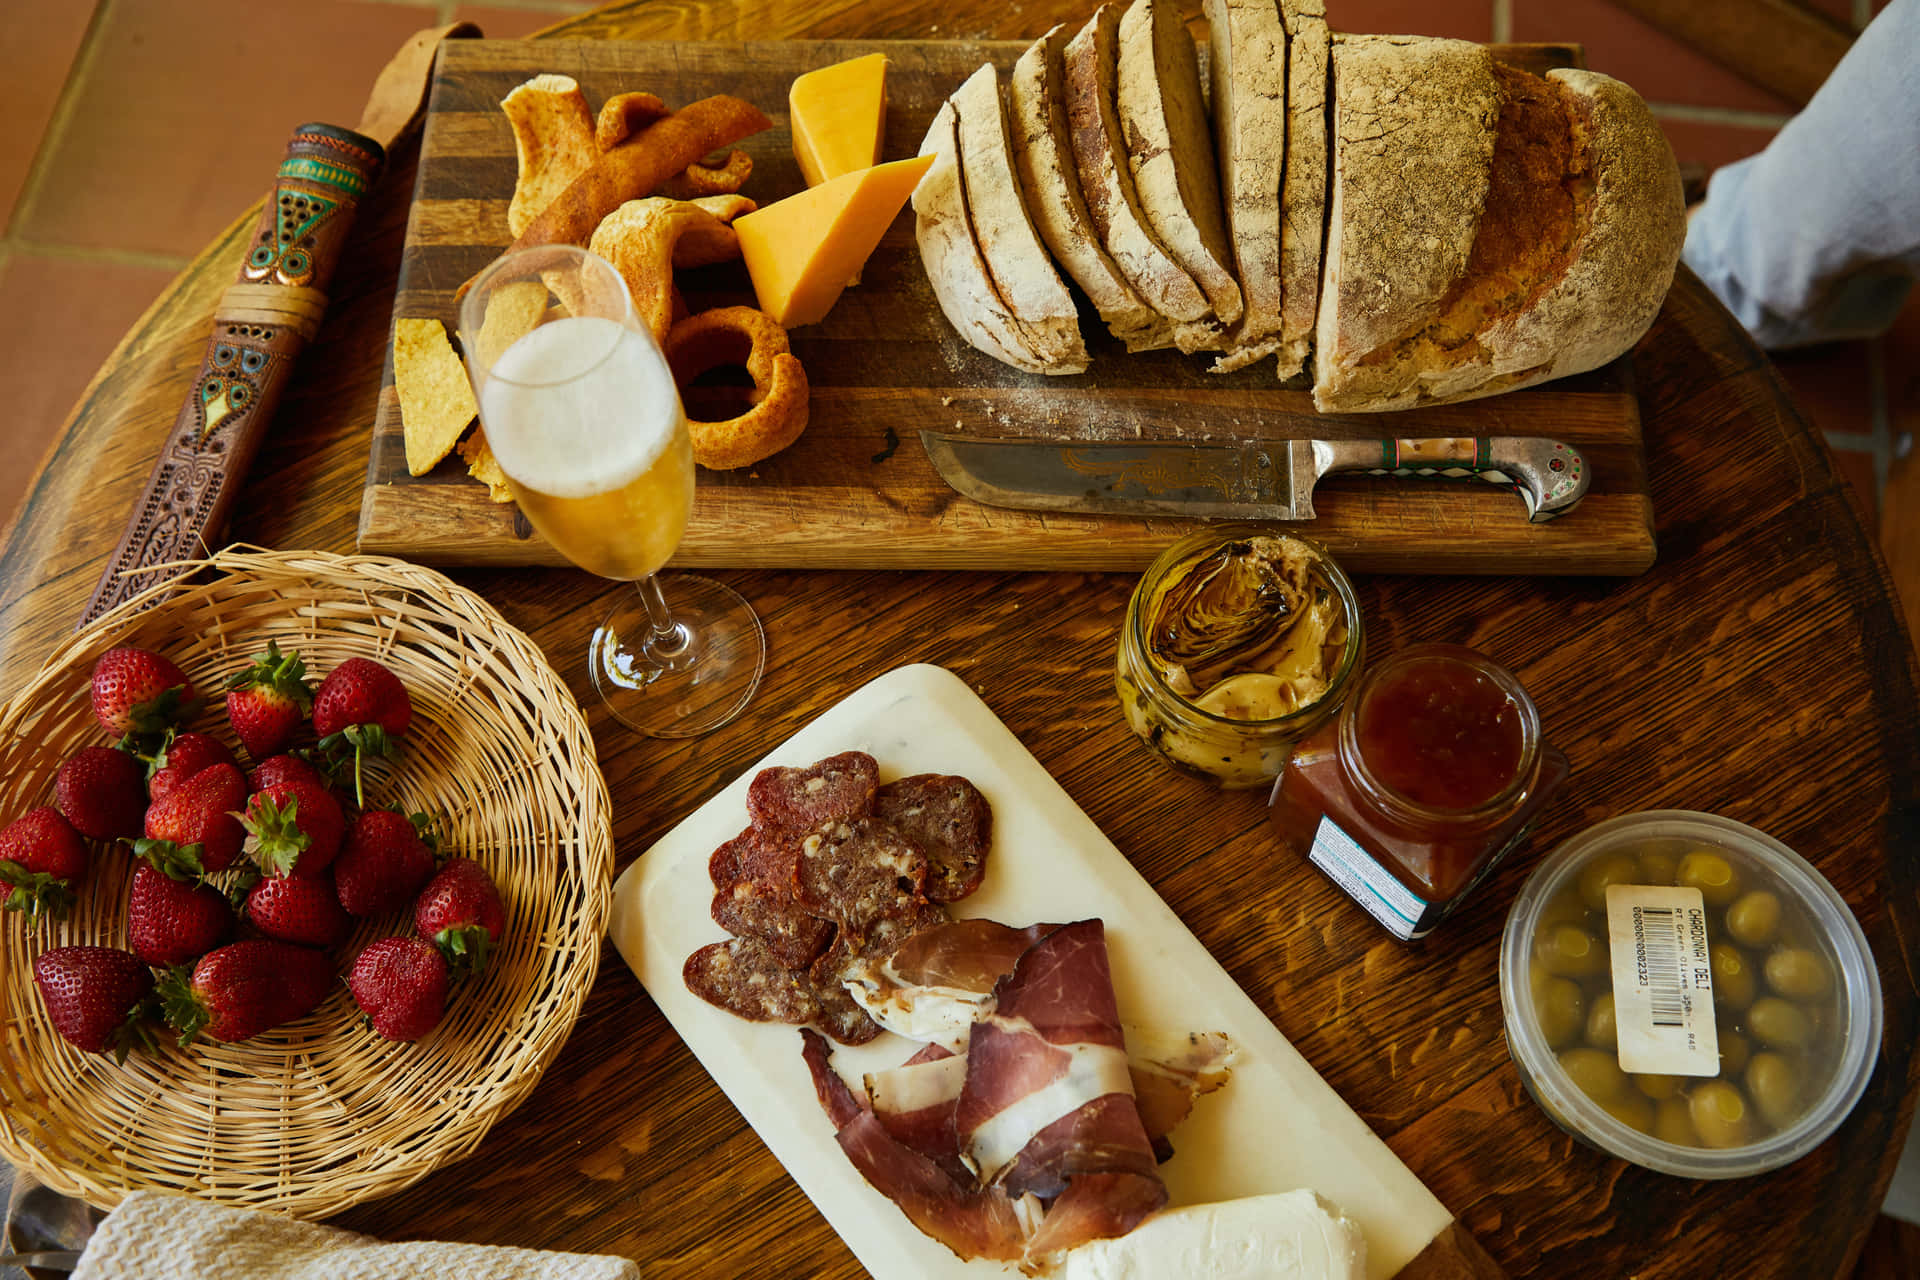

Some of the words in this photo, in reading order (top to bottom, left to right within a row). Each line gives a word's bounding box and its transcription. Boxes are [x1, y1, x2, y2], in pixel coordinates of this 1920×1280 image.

[1676, 907, 1683, 919] RT
[1676, 924, 1684, 951] Green
[1688, 908, 1706, 963] CHARDONNAY
[1694, 968, 1710, 990] DELI
